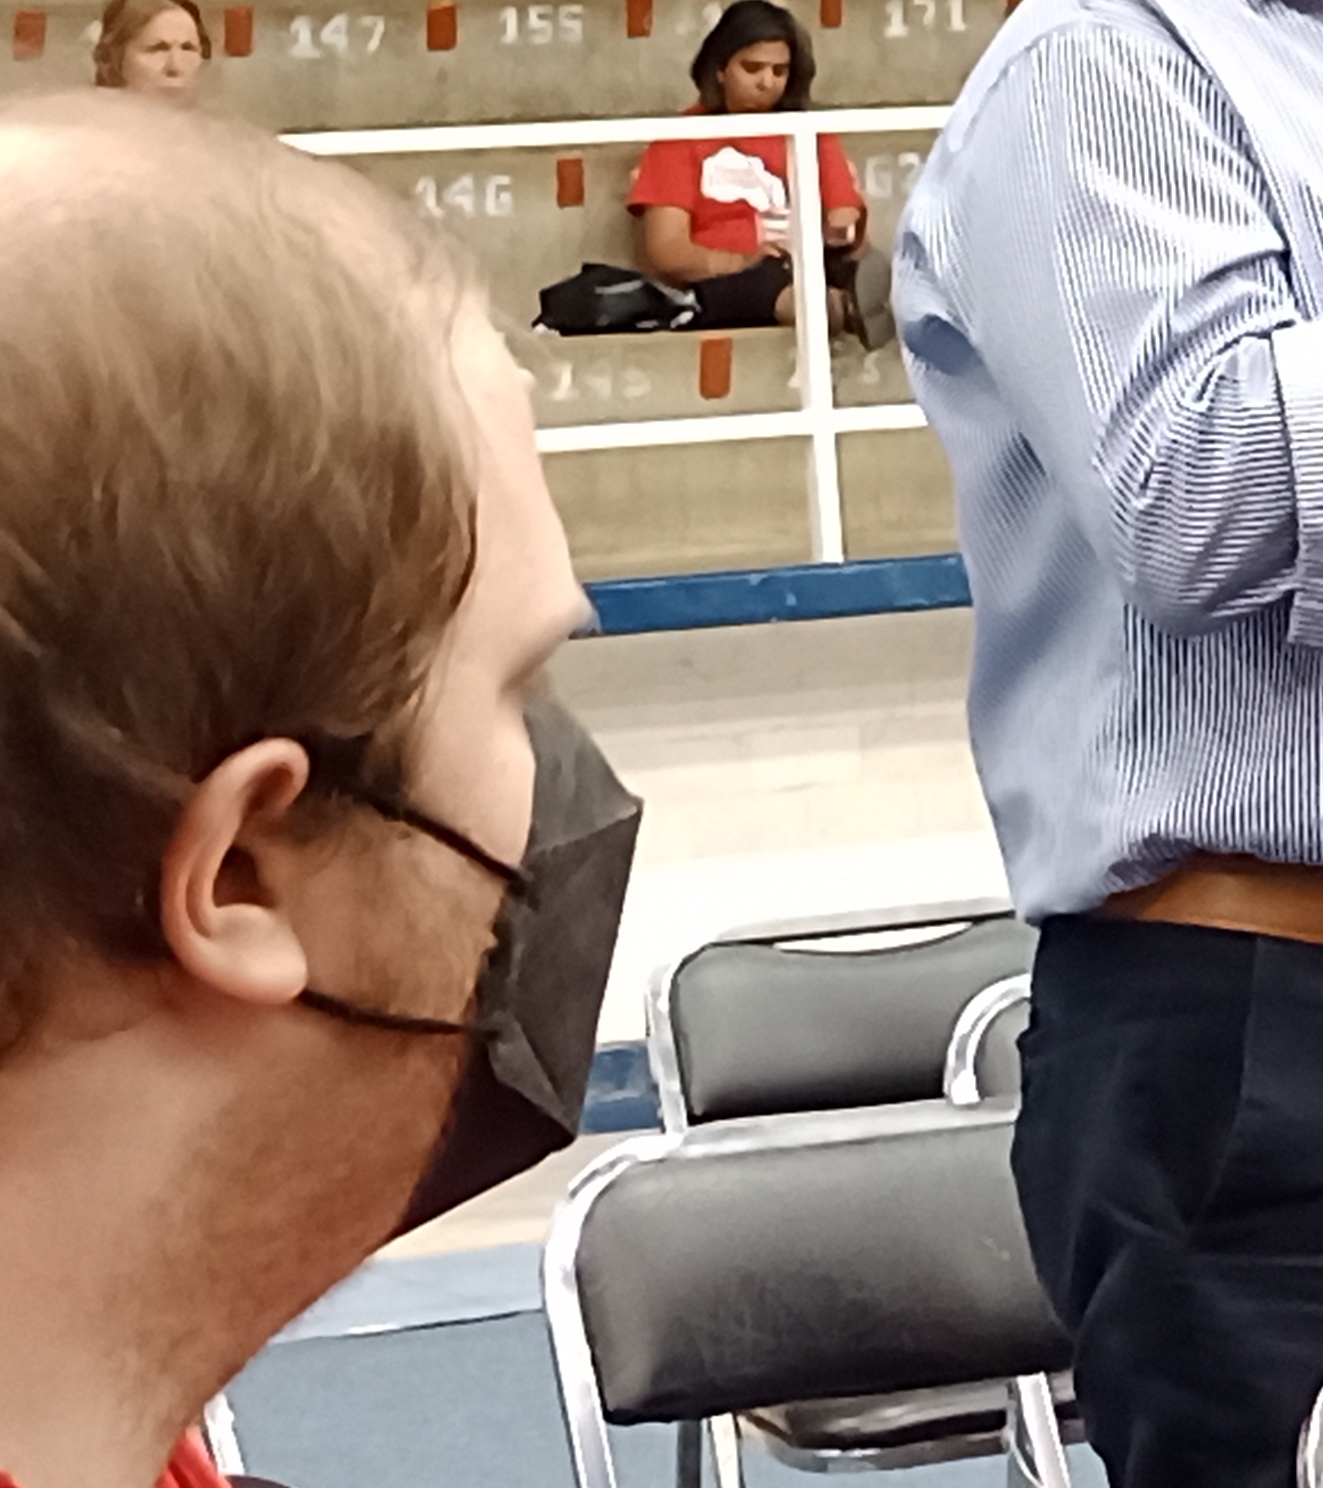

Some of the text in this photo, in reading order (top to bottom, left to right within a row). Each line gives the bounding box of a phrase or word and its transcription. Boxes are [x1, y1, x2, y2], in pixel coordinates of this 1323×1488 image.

[288, 12, 385, 60] 147
[498, 4, 584, 45] 155
[414, 173, 515, 219] 146
